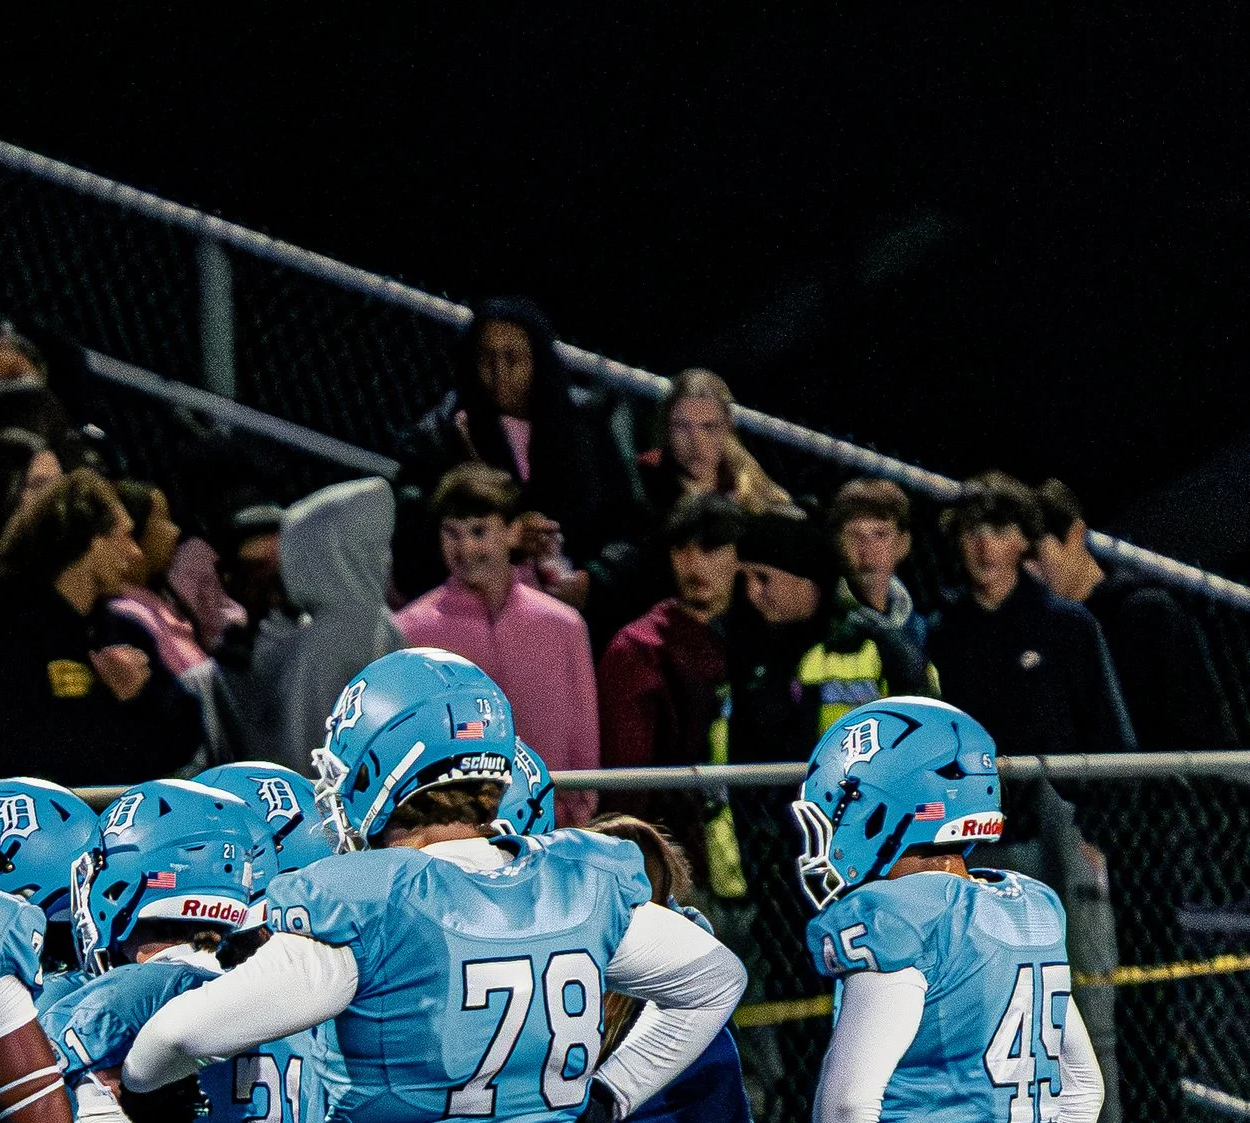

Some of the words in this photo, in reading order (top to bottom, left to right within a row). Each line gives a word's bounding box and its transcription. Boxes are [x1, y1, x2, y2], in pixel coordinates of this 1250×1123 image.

[841, 718, 881, 775] D
[103, 792, 145, 838] D
[250, 776, 301, 823] D
[223, 843, 236, 859] 21
[181, 899, 248, 927] Riddell
[442, 948, 604, 1119] 78
